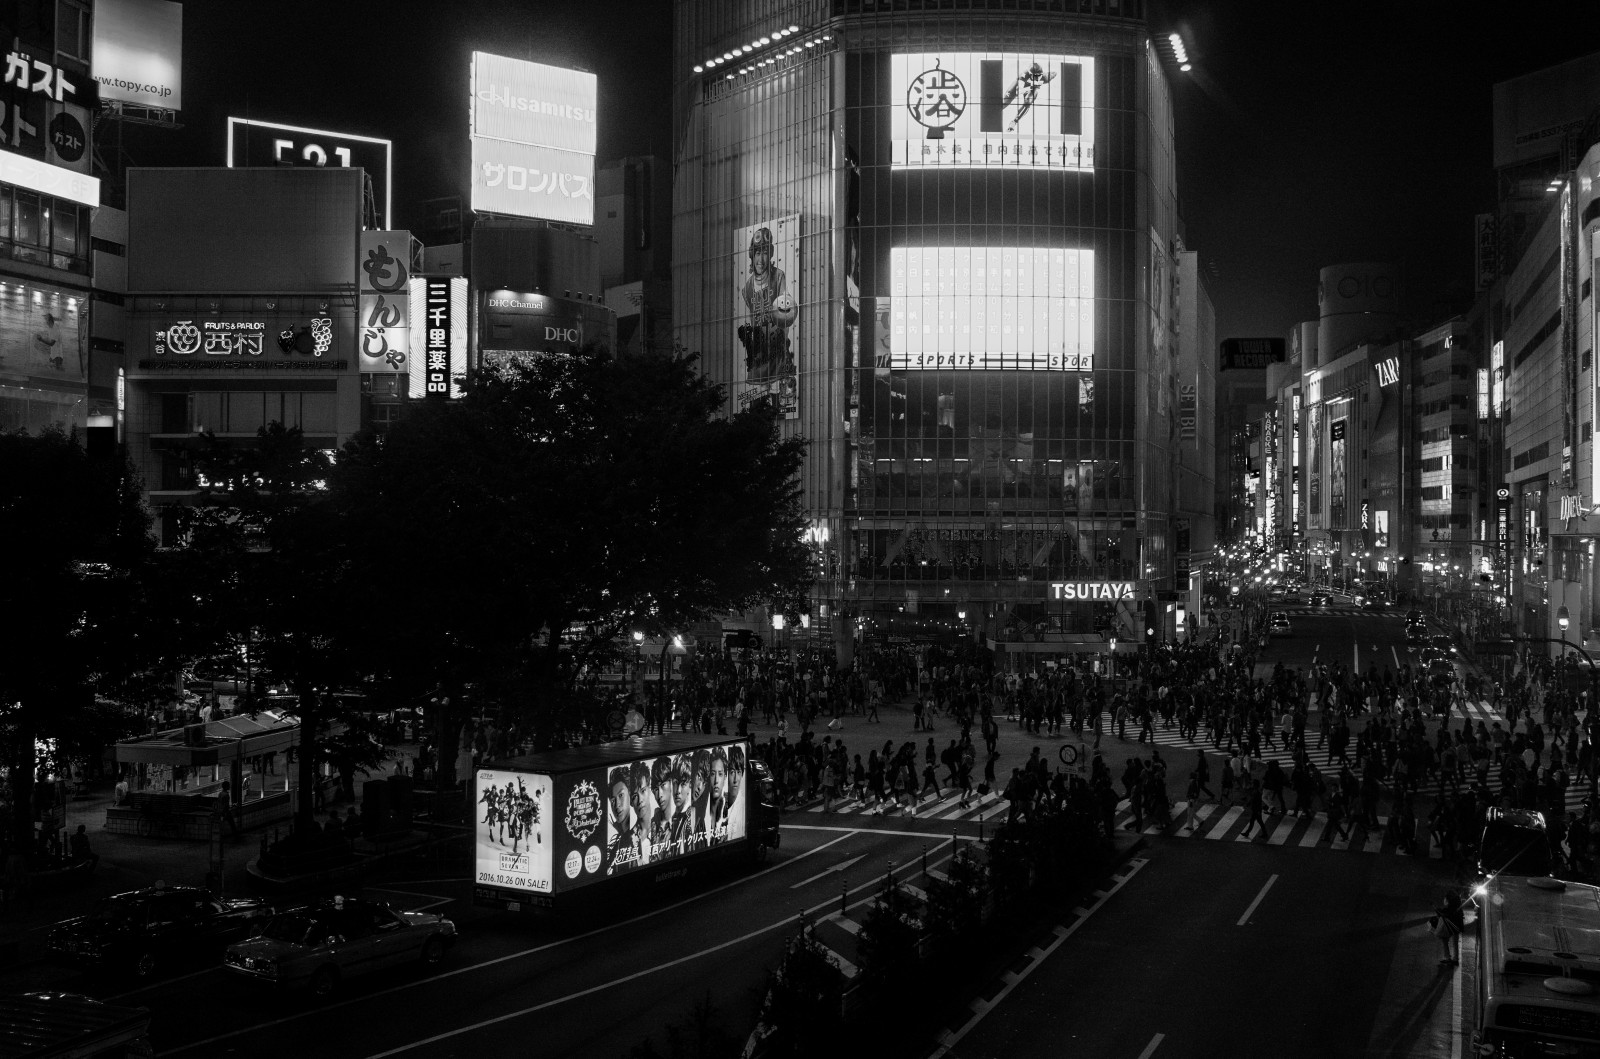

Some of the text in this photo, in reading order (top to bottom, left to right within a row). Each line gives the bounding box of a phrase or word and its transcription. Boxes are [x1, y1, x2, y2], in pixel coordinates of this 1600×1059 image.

[4, 51, 77, 102] ガスト
[94, 76, 172, 97] w.topy.co.jp
[54, 131, 83, 149] ガスト
[482, 161, 592, 201] サロンパス
[362, 244, 408, 371] もんじゃ
[489, 298, 543, 310] DHC Channel
[204, 331, 265, 356] 西村
[427, 283, 448, 393] 三千里薬品
[544, 326, 578, 343] DHC
[916, 354, 1089, 368] SPORTS SPOR
[1264, 411, 1273, 455] KARAOKE
[1360, 503, 1369, 530] ZARA
[1051, 582, 1135, 600] TSUTAYA
[501, 855, 528, 865] DRAMATIC
[479, 872, 549, 890] 2016.10.26 ON SALE!
